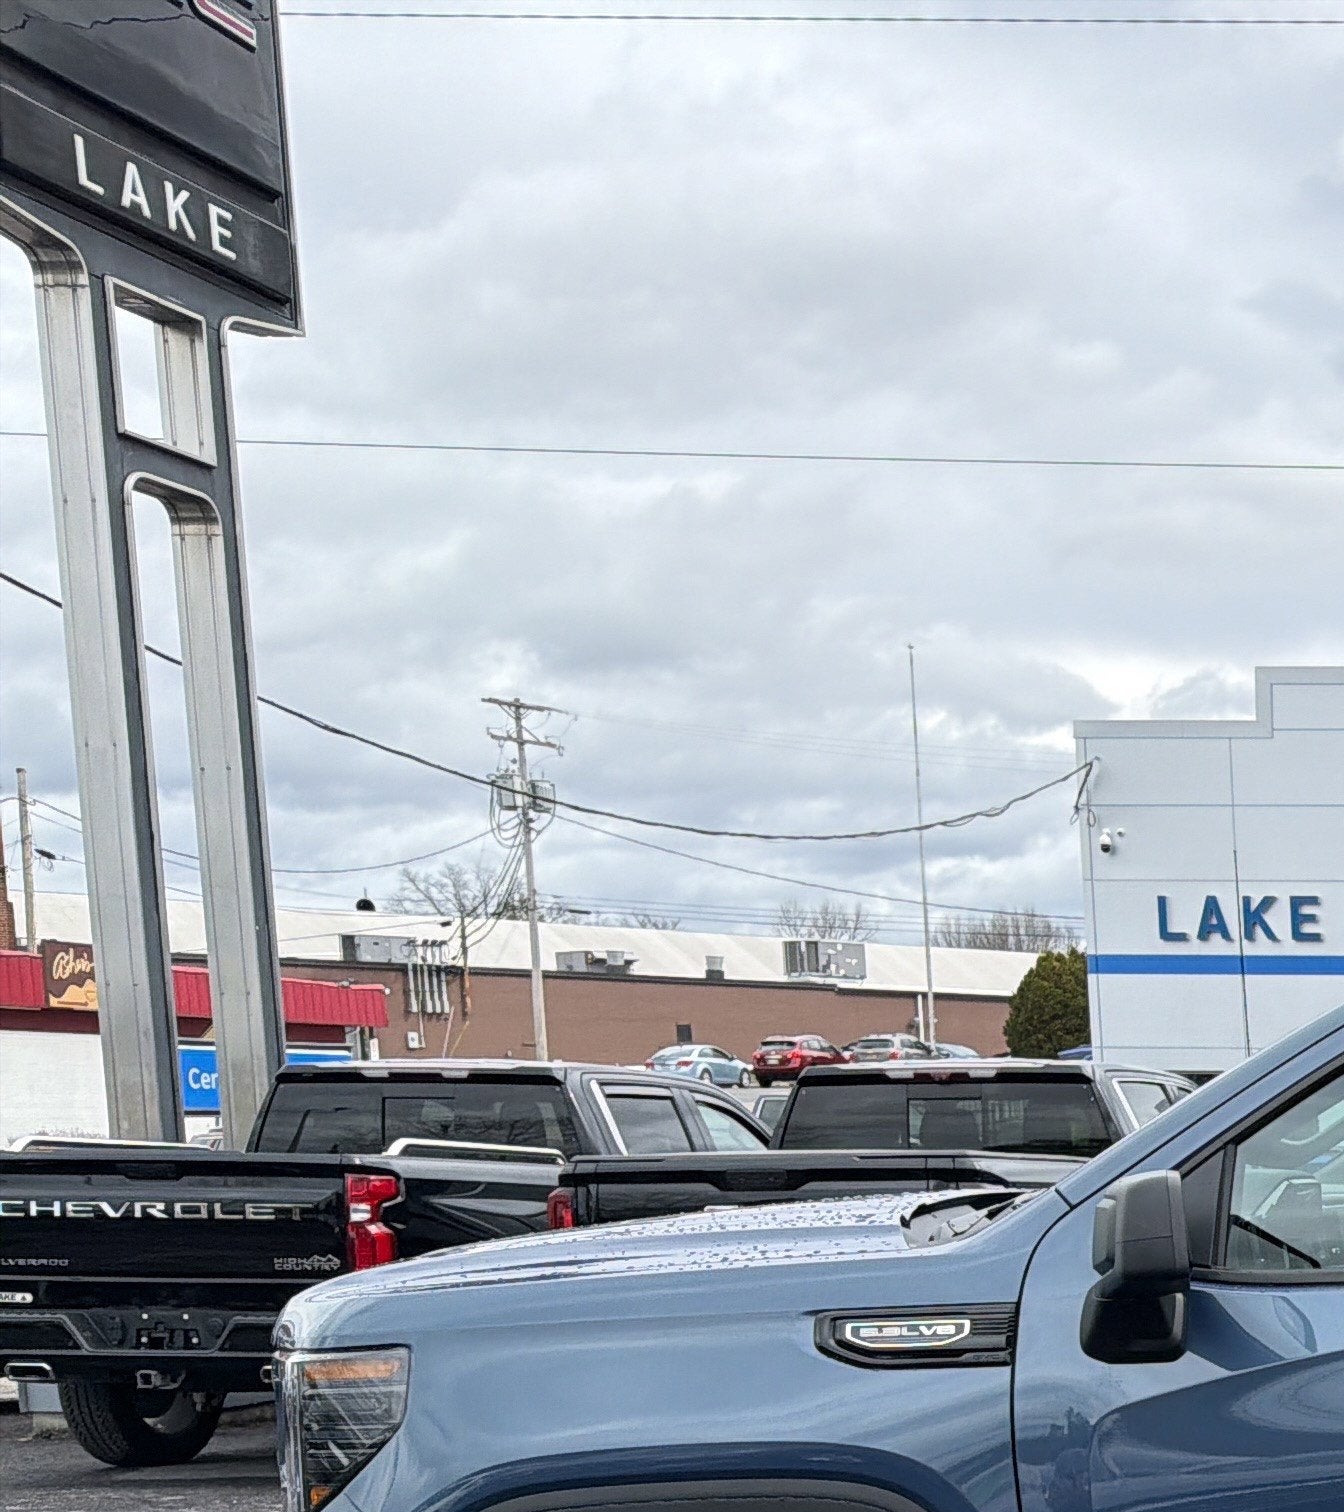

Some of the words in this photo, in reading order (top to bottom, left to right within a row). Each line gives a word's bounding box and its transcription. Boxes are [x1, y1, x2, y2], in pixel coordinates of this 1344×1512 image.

[72, 133, 238, 262] LAKE
[1157, 895, 1324, 943] LAKE
[188, 1067, 219, 1090] Cer
[0, 1200, 315, 1220] CHEVROLET
[0, 1258, 69, 1266] LVERADO
[0, 1292, 17, 1301] AKE
